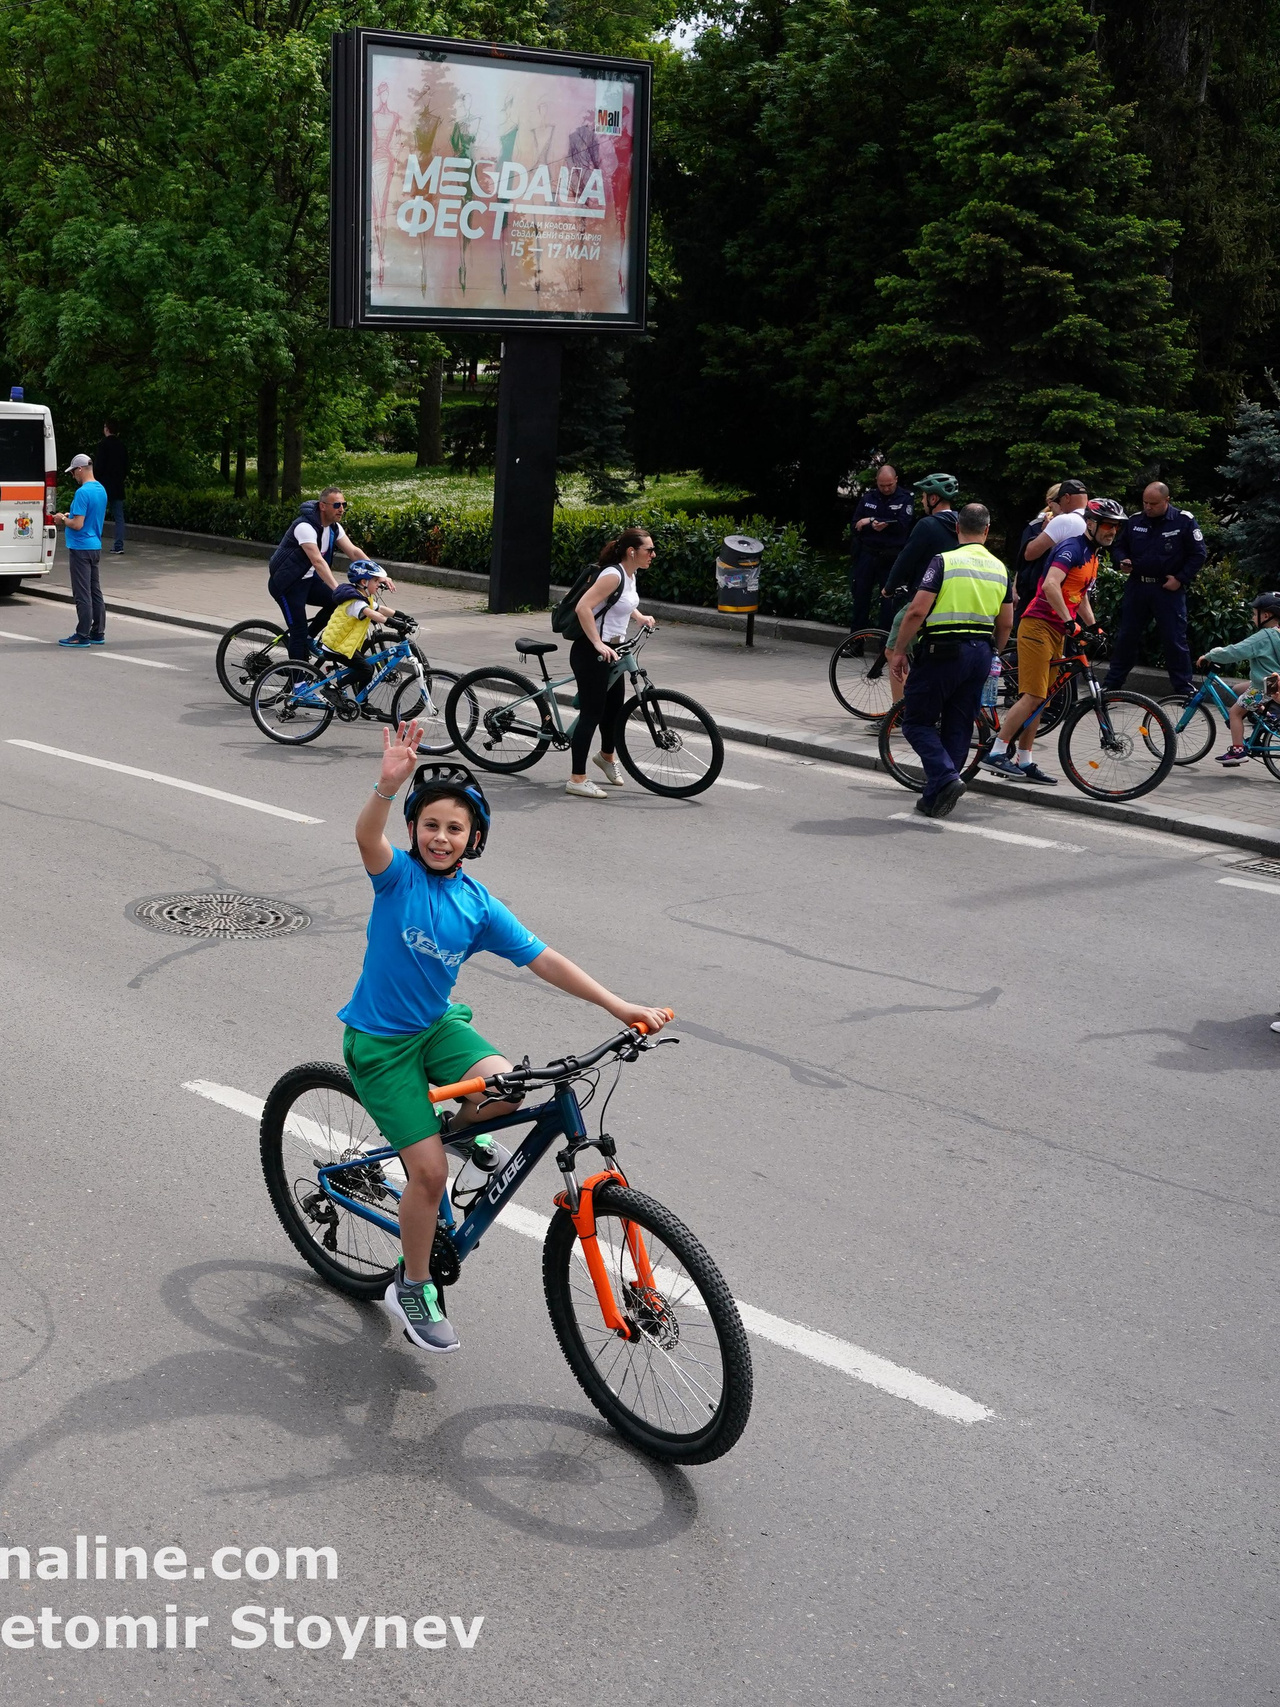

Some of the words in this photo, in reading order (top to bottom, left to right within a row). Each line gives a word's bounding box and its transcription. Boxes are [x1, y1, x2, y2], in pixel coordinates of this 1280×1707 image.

[598, 109, 620, 127] Mall
[396, 196, 514, 240] ФЕСТ
[512, 220, 535, 228] МОДА
[510, 241, 525, 257] 15
[547, 243, 562, 259] 17
[565, 242, 601, 260] МАЙ
[487, 1150, 527, 1205] CUBE
